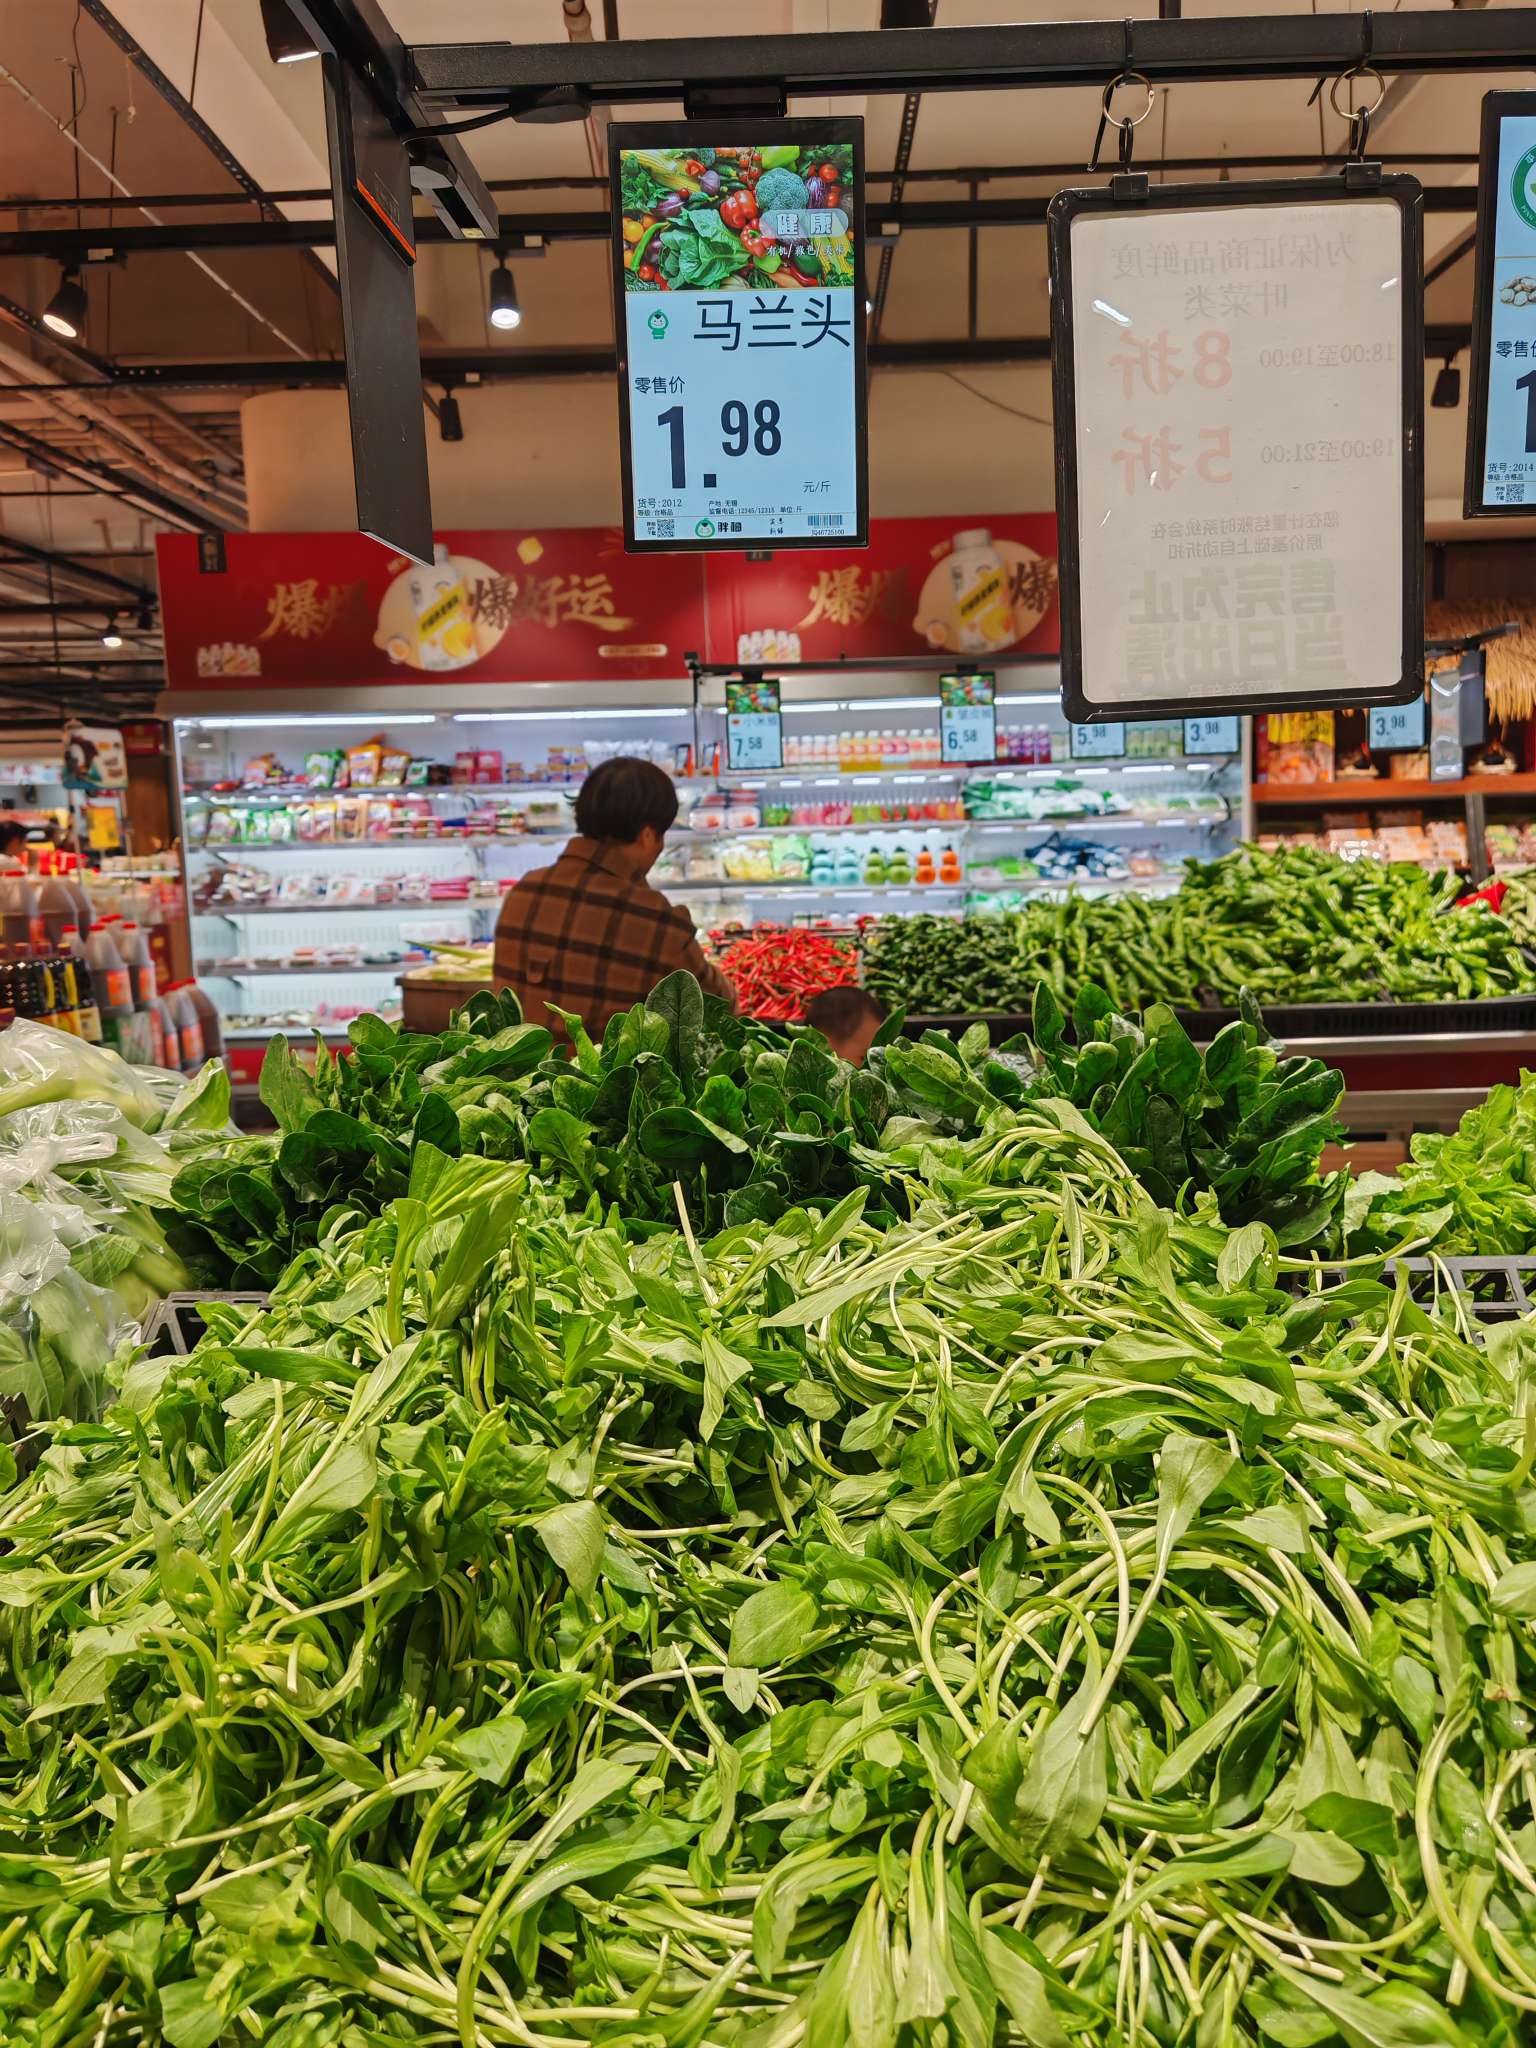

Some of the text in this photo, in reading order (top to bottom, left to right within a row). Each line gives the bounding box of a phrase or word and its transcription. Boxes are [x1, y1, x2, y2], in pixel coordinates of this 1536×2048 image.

[777, 213, 832, 235] 健康
[693, 294, 851, 351] 马兰头
[635, 375, 686, 395] 零售价
[657, 399, 782, 489] 1.98
[1488, 462, 1534, 474] 货号:2014
[802, 480, 832, 493] 元/斤
[638, 497, 683, 508] 货号:2012
[1375, 714, 1406, 736] 3.98
[734, 737, 762, 756] 7.58
[948, 730, 977, 750] 6.58
